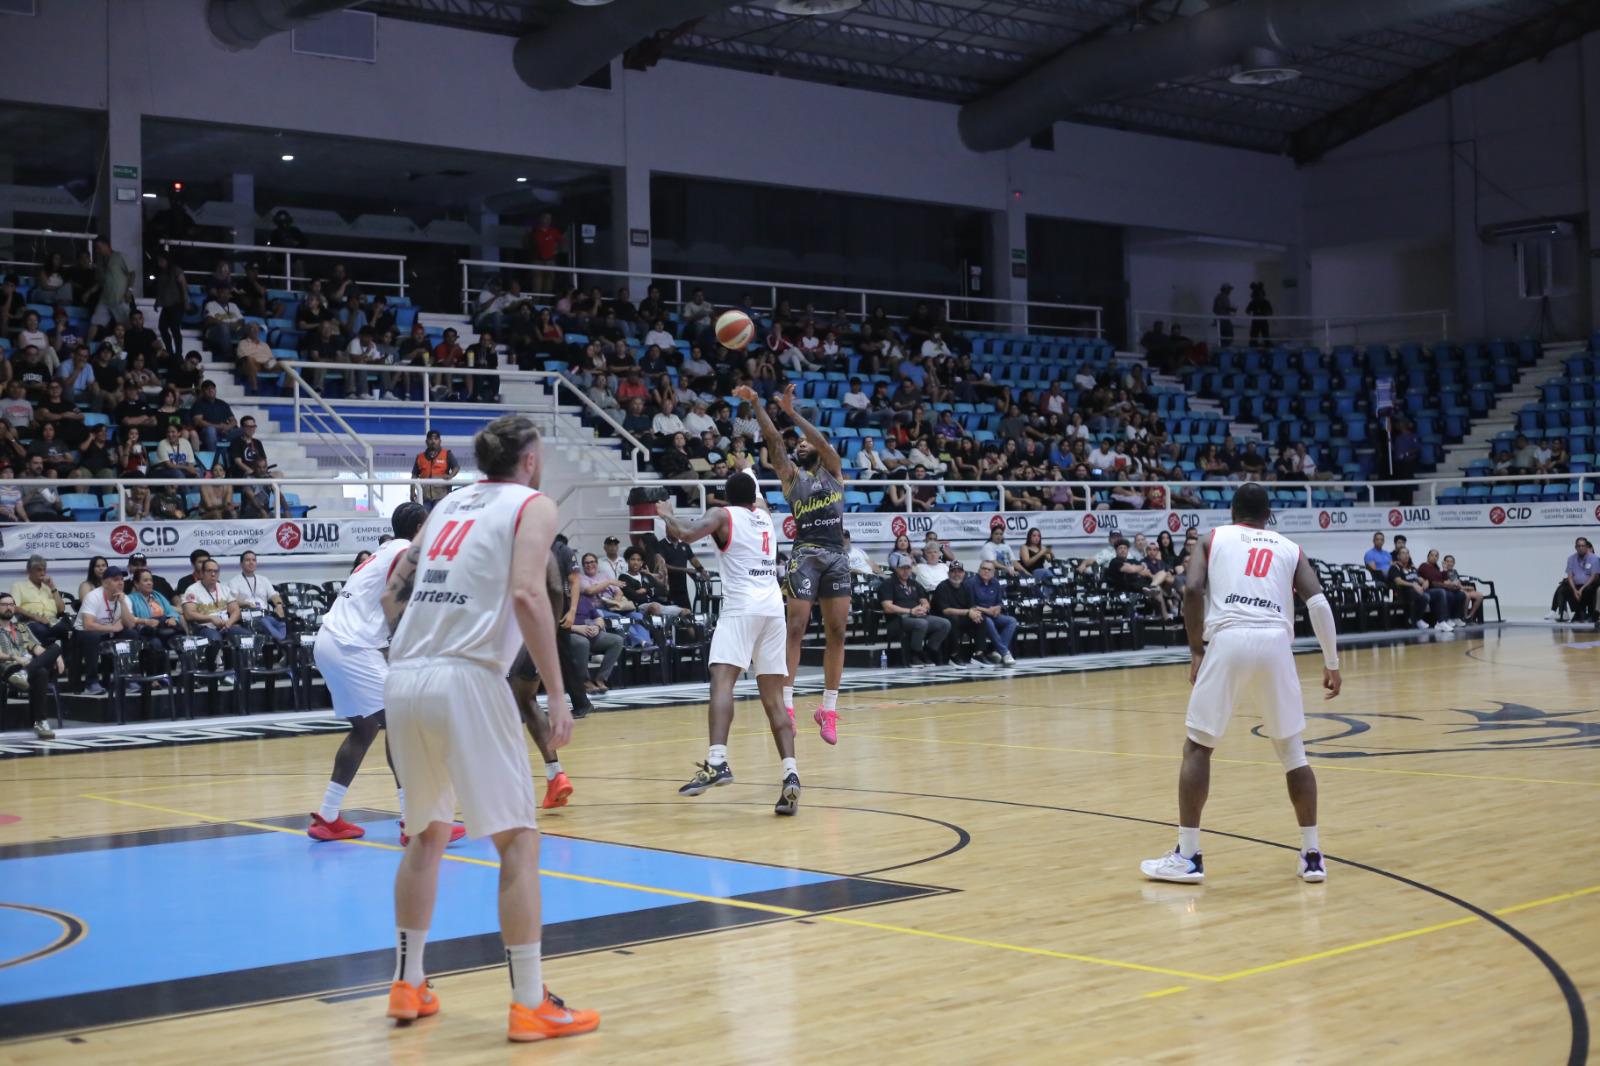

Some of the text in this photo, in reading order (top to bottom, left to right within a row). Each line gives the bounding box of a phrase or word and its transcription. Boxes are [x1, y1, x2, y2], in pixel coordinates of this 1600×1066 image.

[1331, 511, 1348, 524] CID
[1404, 508, 1431, 521] UAD
[1506, 507, 1532, 520] CID
[814, 517, 841, 526] Coppe
[908, 516, 933, 532] UAD
[1006, 516, 1029, 531] CID
[1097, 514, 1119, 528] UAD
[1181, 514, 1200, 528] CID
[19, 531, 95, 540] SIEMPRE GRANDES
[139, 526, 180, 546] CID
[193, 528, 264, 537] SIEMPRE GRANDES
[302, 523, 340, 542] UAD
[355, 535, 381, 543] SIEMP
[25, 541, 90, 550] SIEMPRE LOBOS
[199, 538, 259, 547] SIEMPRE LOBOS
[427, 519, 476, 561] 44
[1244, 547, 1274, 578] 10
